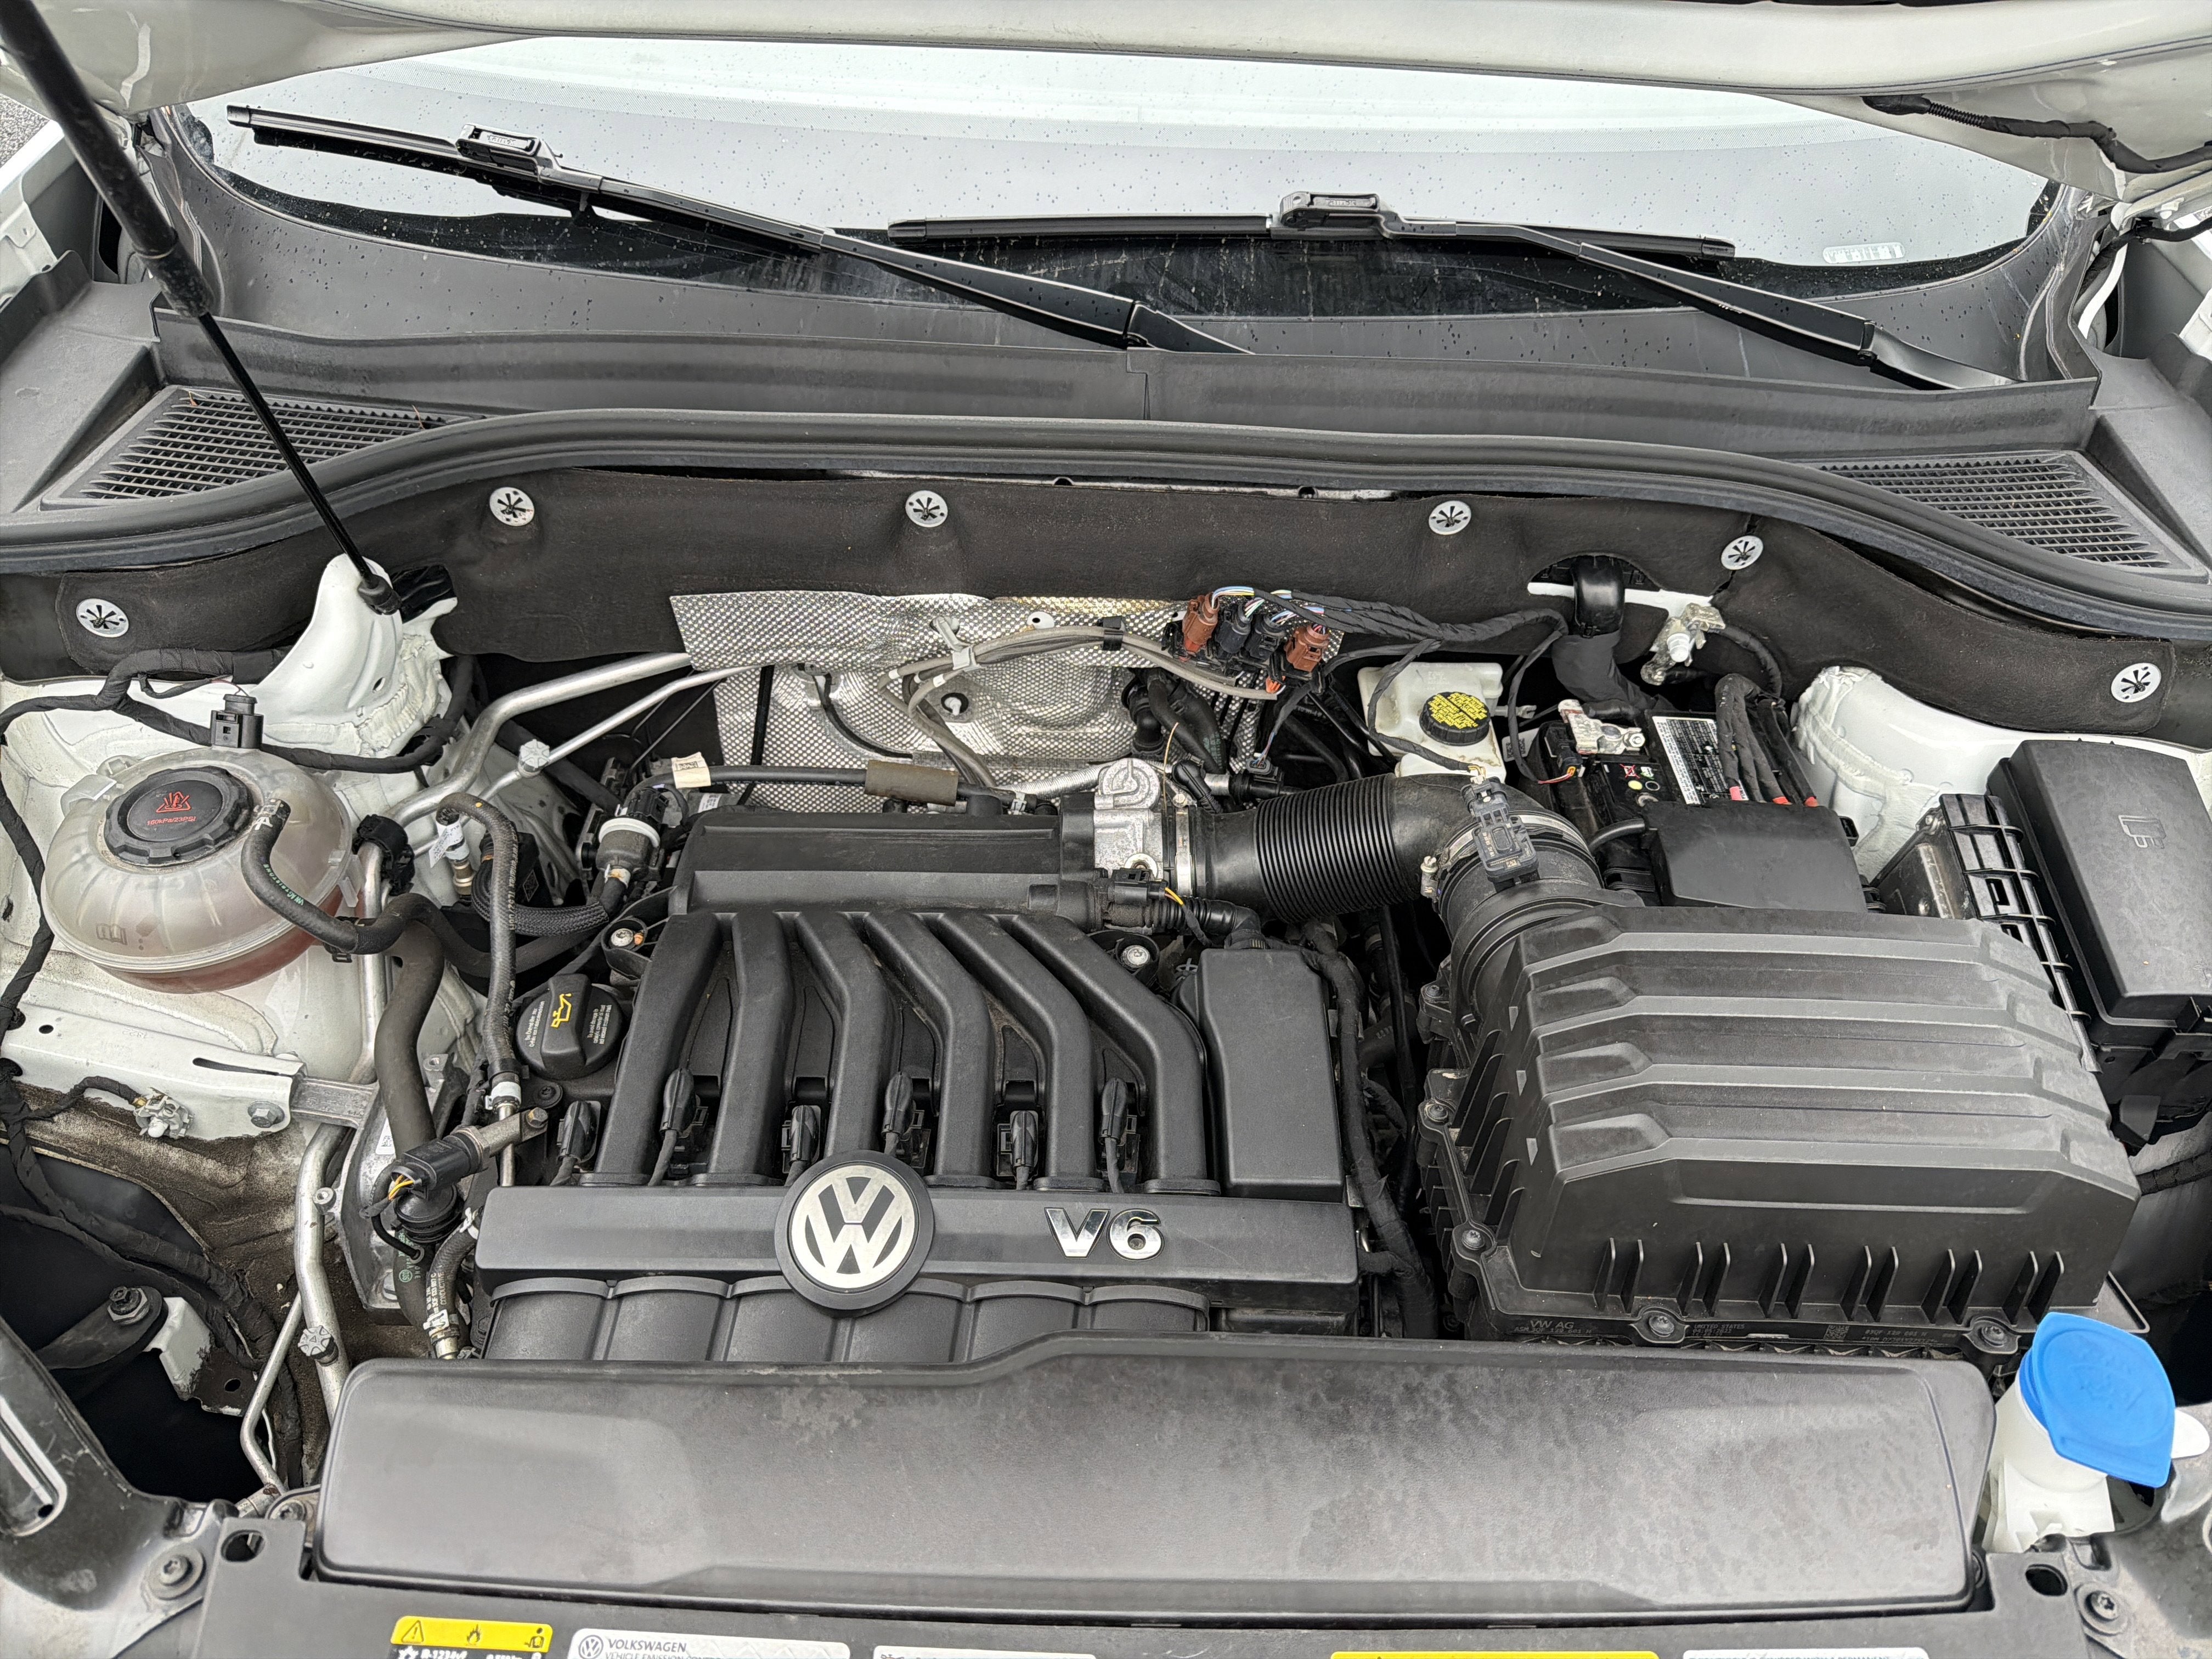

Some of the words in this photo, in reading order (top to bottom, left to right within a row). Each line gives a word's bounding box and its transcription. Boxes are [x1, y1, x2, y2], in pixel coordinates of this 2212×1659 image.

[147, 816, 196, 826] 160kPa/23PSI
[1044, 1207, 1165, 1261] V6
[438, 1272, 447, 1305] CONDUCTIVE
[1530, 1320, 1553, 1328] VW
[608, 1638, 687, 1652] VOLKSWAGEN
